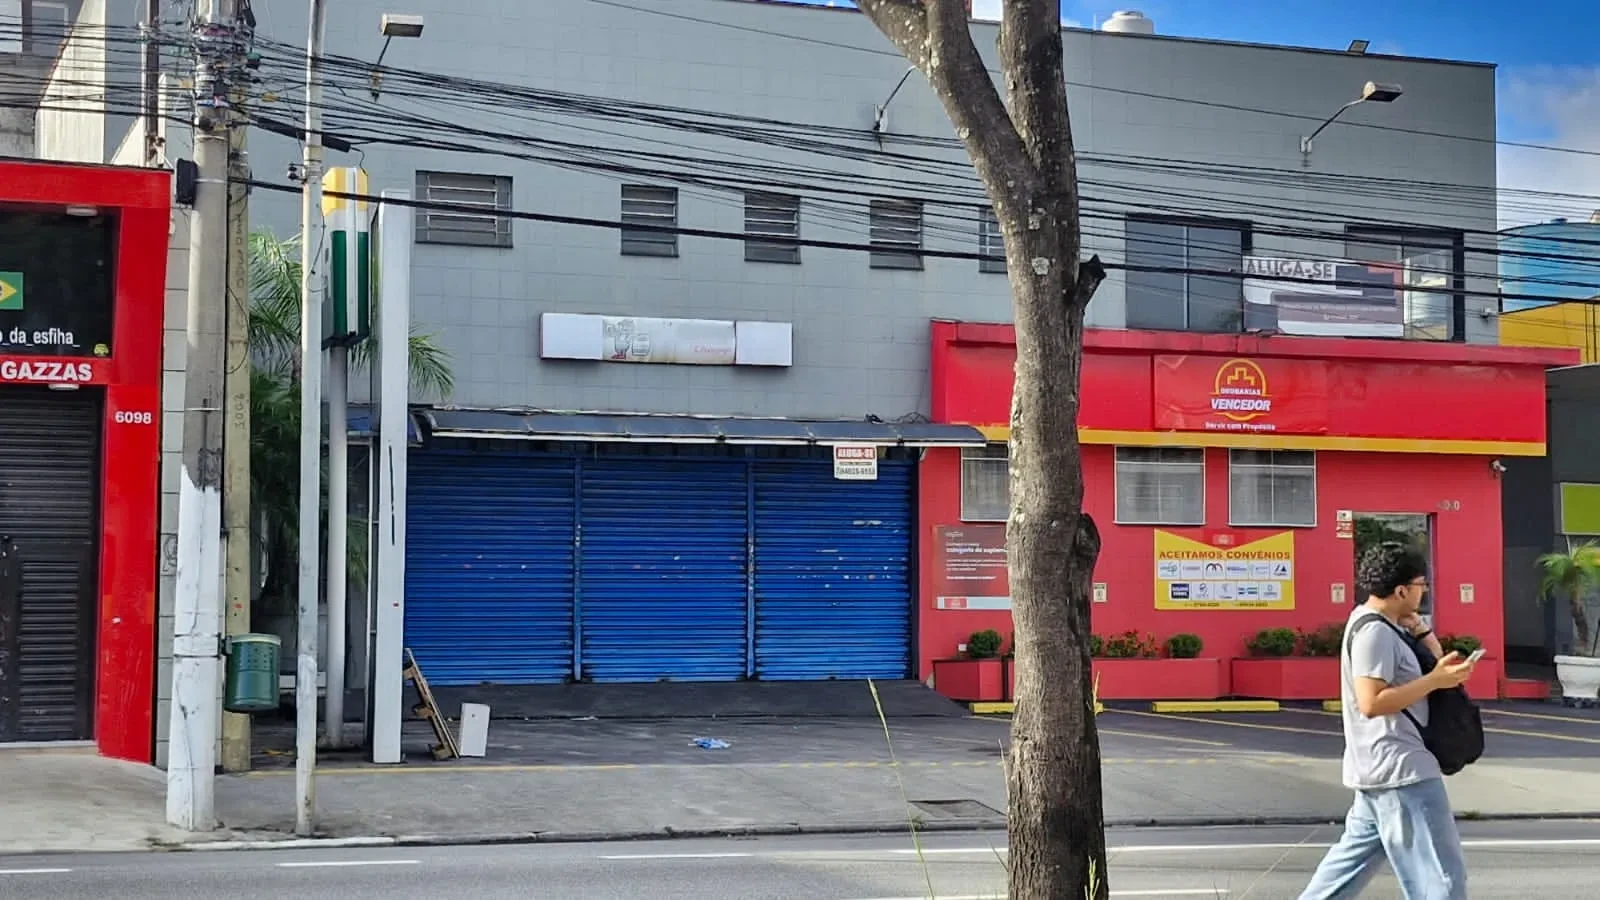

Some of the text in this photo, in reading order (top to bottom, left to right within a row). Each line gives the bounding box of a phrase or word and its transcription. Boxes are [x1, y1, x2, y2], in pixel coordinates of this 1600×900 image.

[1247, 260, 1333, 280] ALUGA-SE
[0, 326, 80, 347] _da_esfiha_
[1, 361, 93, 381] GAZZAS
[1211, 398, 1272, 411] VENCEDOR
[115, 411, 152, 424] 6098
[1159, 550, 1290, 559] ACEITAMOS CONVÊNIOS
